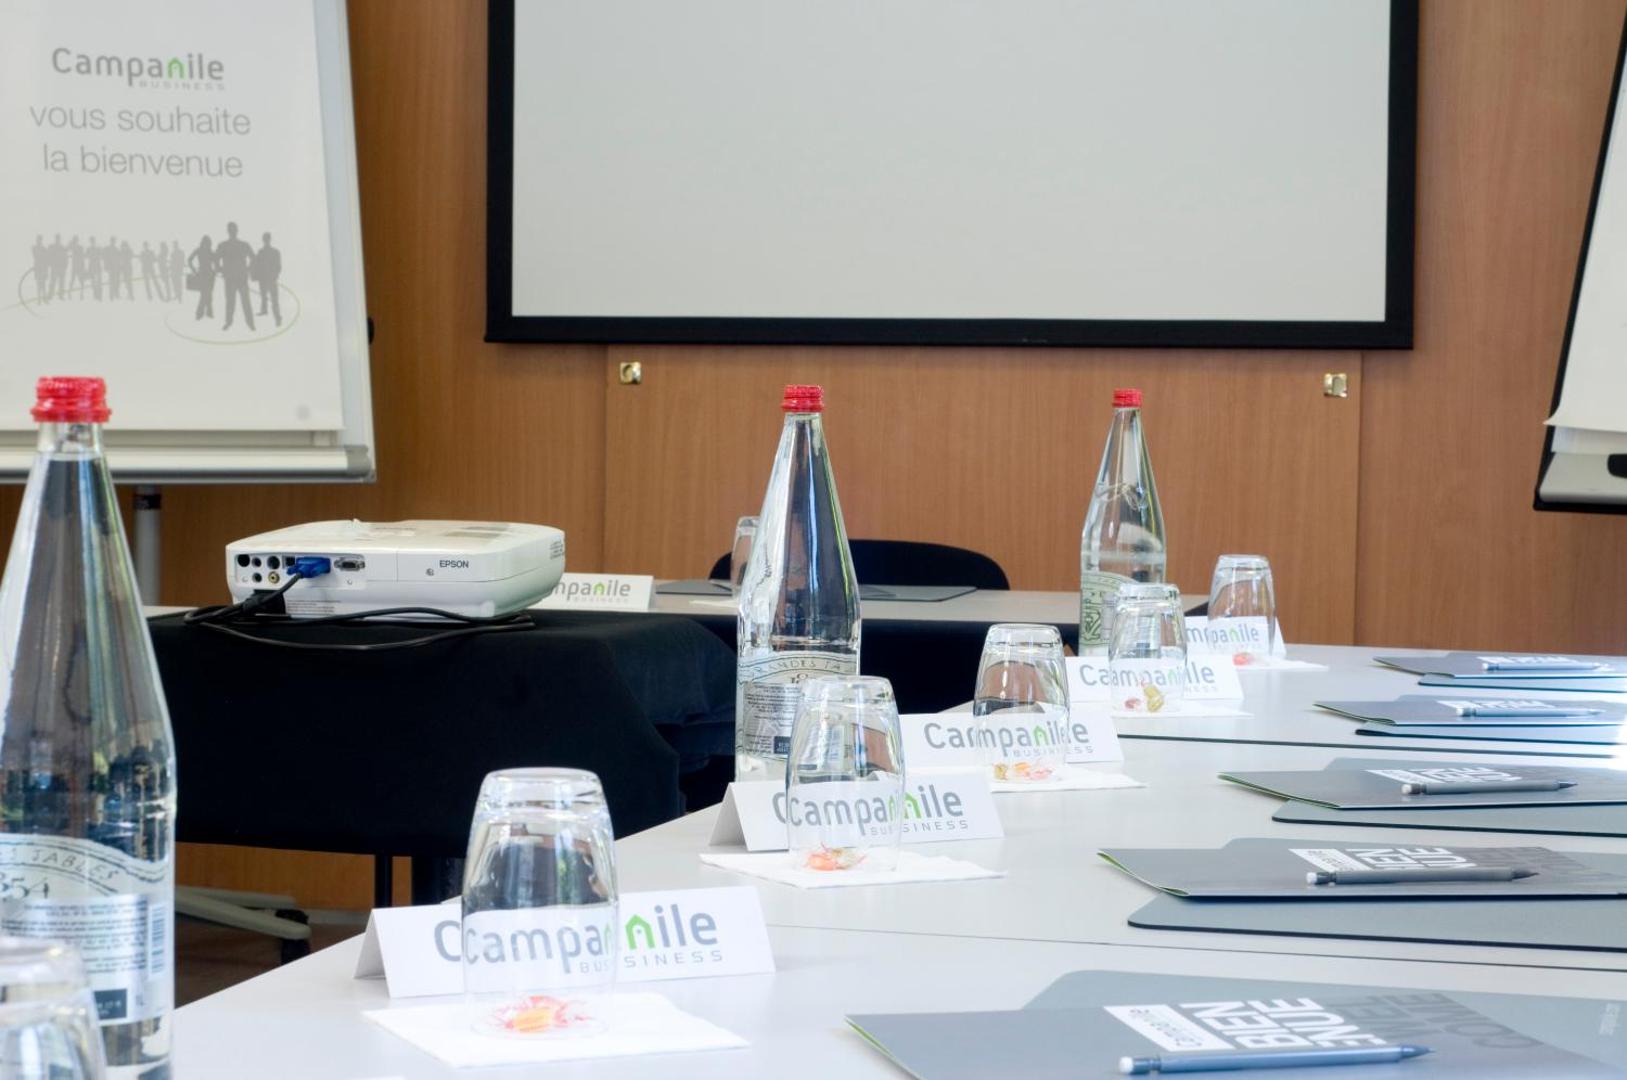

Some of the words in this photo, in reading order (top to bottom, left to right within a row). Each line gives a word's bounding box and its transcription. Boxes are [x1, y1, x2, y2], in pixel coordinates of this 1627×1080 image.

[52, 47, 225, 87] Campanile
[29, 106, 106, 130] vous
[117, 105, 252, 136] souhaite
[43, 144, 69, 172] la
[80, 145, 243, 178] bienvenue
[439, 559, 470, 569] EPSON
[553, 578, 631, 601] mpanile
[923, 721, 1091, 757] Campanile
[771, 784, 964, 836] Campanile
[433, 903, 719, 974] Campanile
